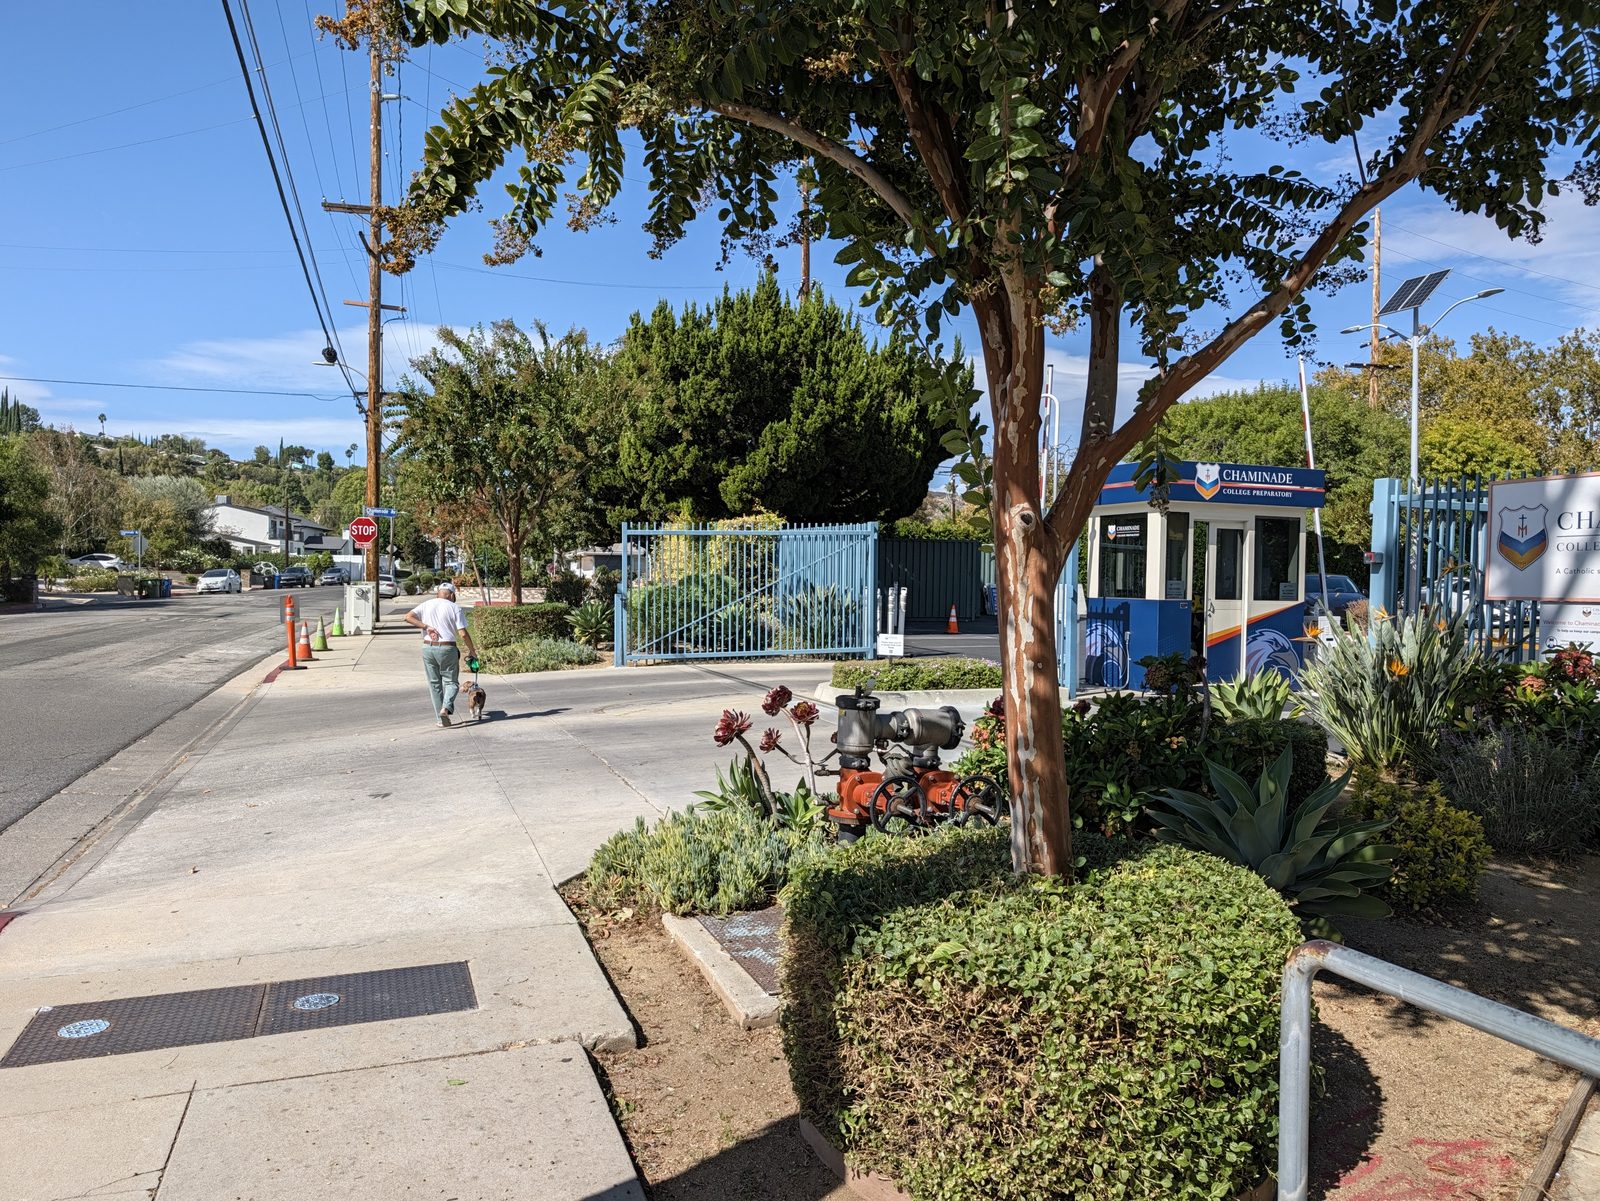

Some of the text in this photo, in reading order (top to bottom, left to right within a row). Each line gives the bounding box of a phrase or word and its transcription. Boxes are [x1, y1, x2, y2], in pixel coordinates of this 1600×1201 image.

[1222, 469, 1293, 484] CHAMINADE
[1222, 488, 1293, 498] COLLEGE PREPARATORY
[351, 525, 375, 536] STOP
[1563, 567, 1594, 575] Catholic
